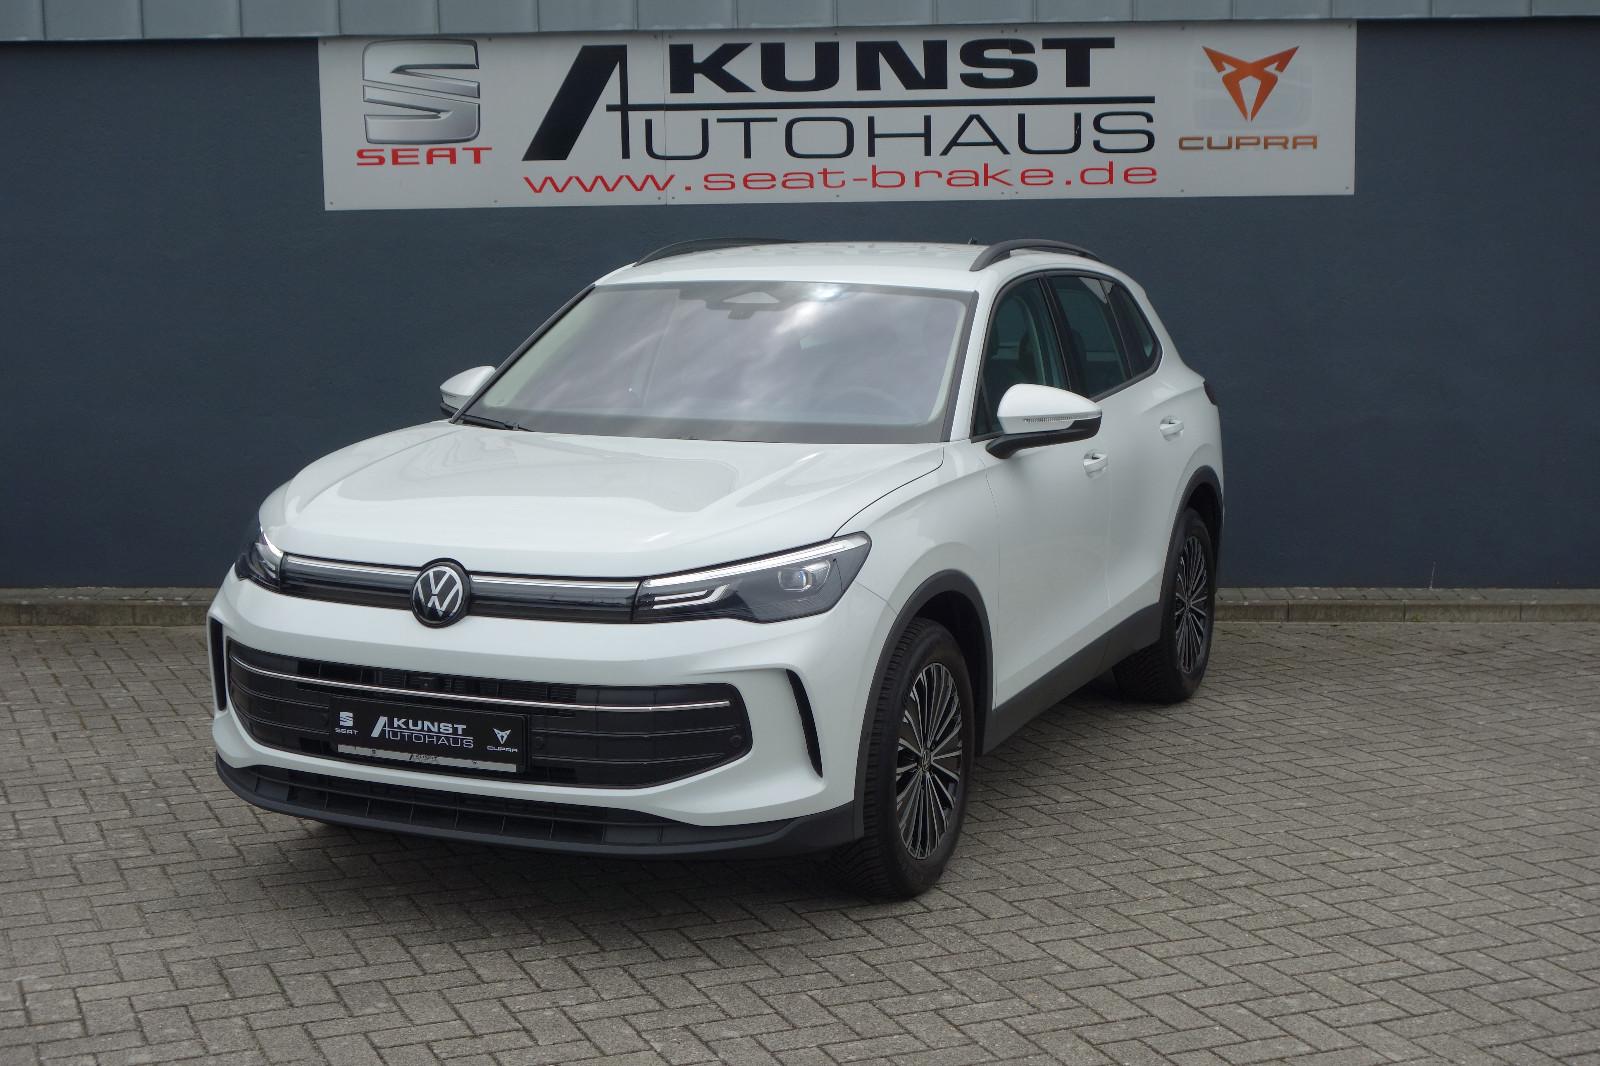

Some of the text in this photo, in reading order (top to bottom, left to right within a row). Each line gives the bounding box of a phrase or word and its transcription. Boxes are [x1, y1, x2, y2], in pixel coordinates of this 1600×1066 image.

[668, 36, 1116, 94] KUNST
[521, 43, 1156, 161] AUTOHAUS
[1177, 133, 1319, 151] CUPRA
[356, 146, 493, 166] SEAT
[522, 160, 1158, 193] www.seat-brake.de
[335, 727, 359, 736] SEAT
[370, 715, 474, 749] AUTOHAUS
[393, 717, 467, 735] KUNST
